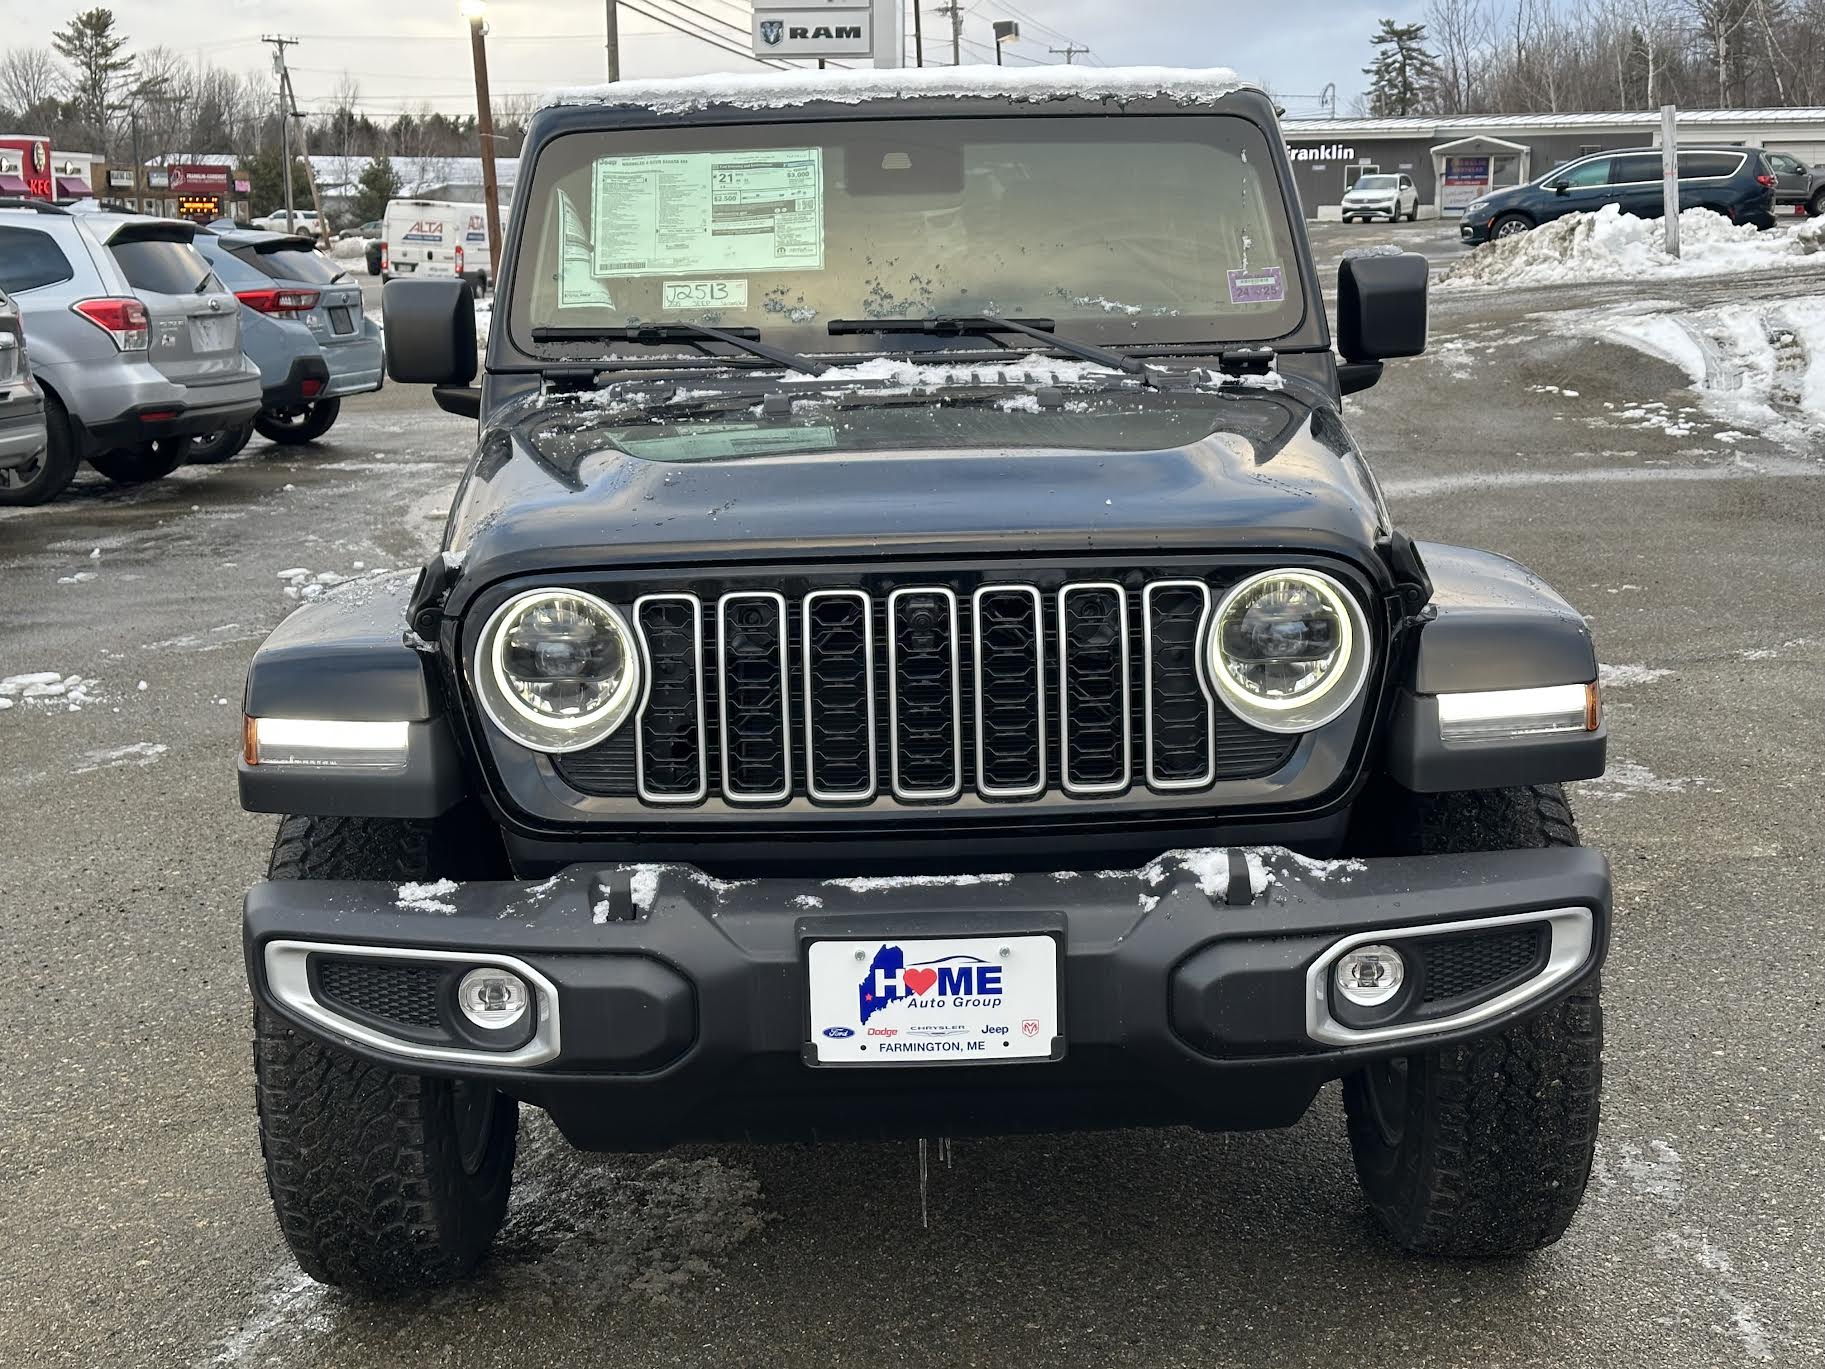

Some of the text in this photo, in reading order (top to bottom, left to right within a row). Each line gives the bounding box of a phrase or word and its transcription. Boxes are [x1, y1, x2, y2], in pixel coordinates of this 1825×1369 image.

[789, 26, 861, 39] RAM
[1287, 144, 1355, 161] ranklin
[719, 173, 733, 183] 21
[30, 178, 51, 195] KFC
[409, 220, 444, 234] ALTA
[467, 215, 485, 230] ALTA
[666, 282, 729, 302] J2513
[907, 996, 1002, 1009] Auto Group
[867, 1027, 898, 1038] Dodge
[981, 1024, 1009, 1035] Jeep
[879, 1041, 986, 1053] FARMINGTON, ME
